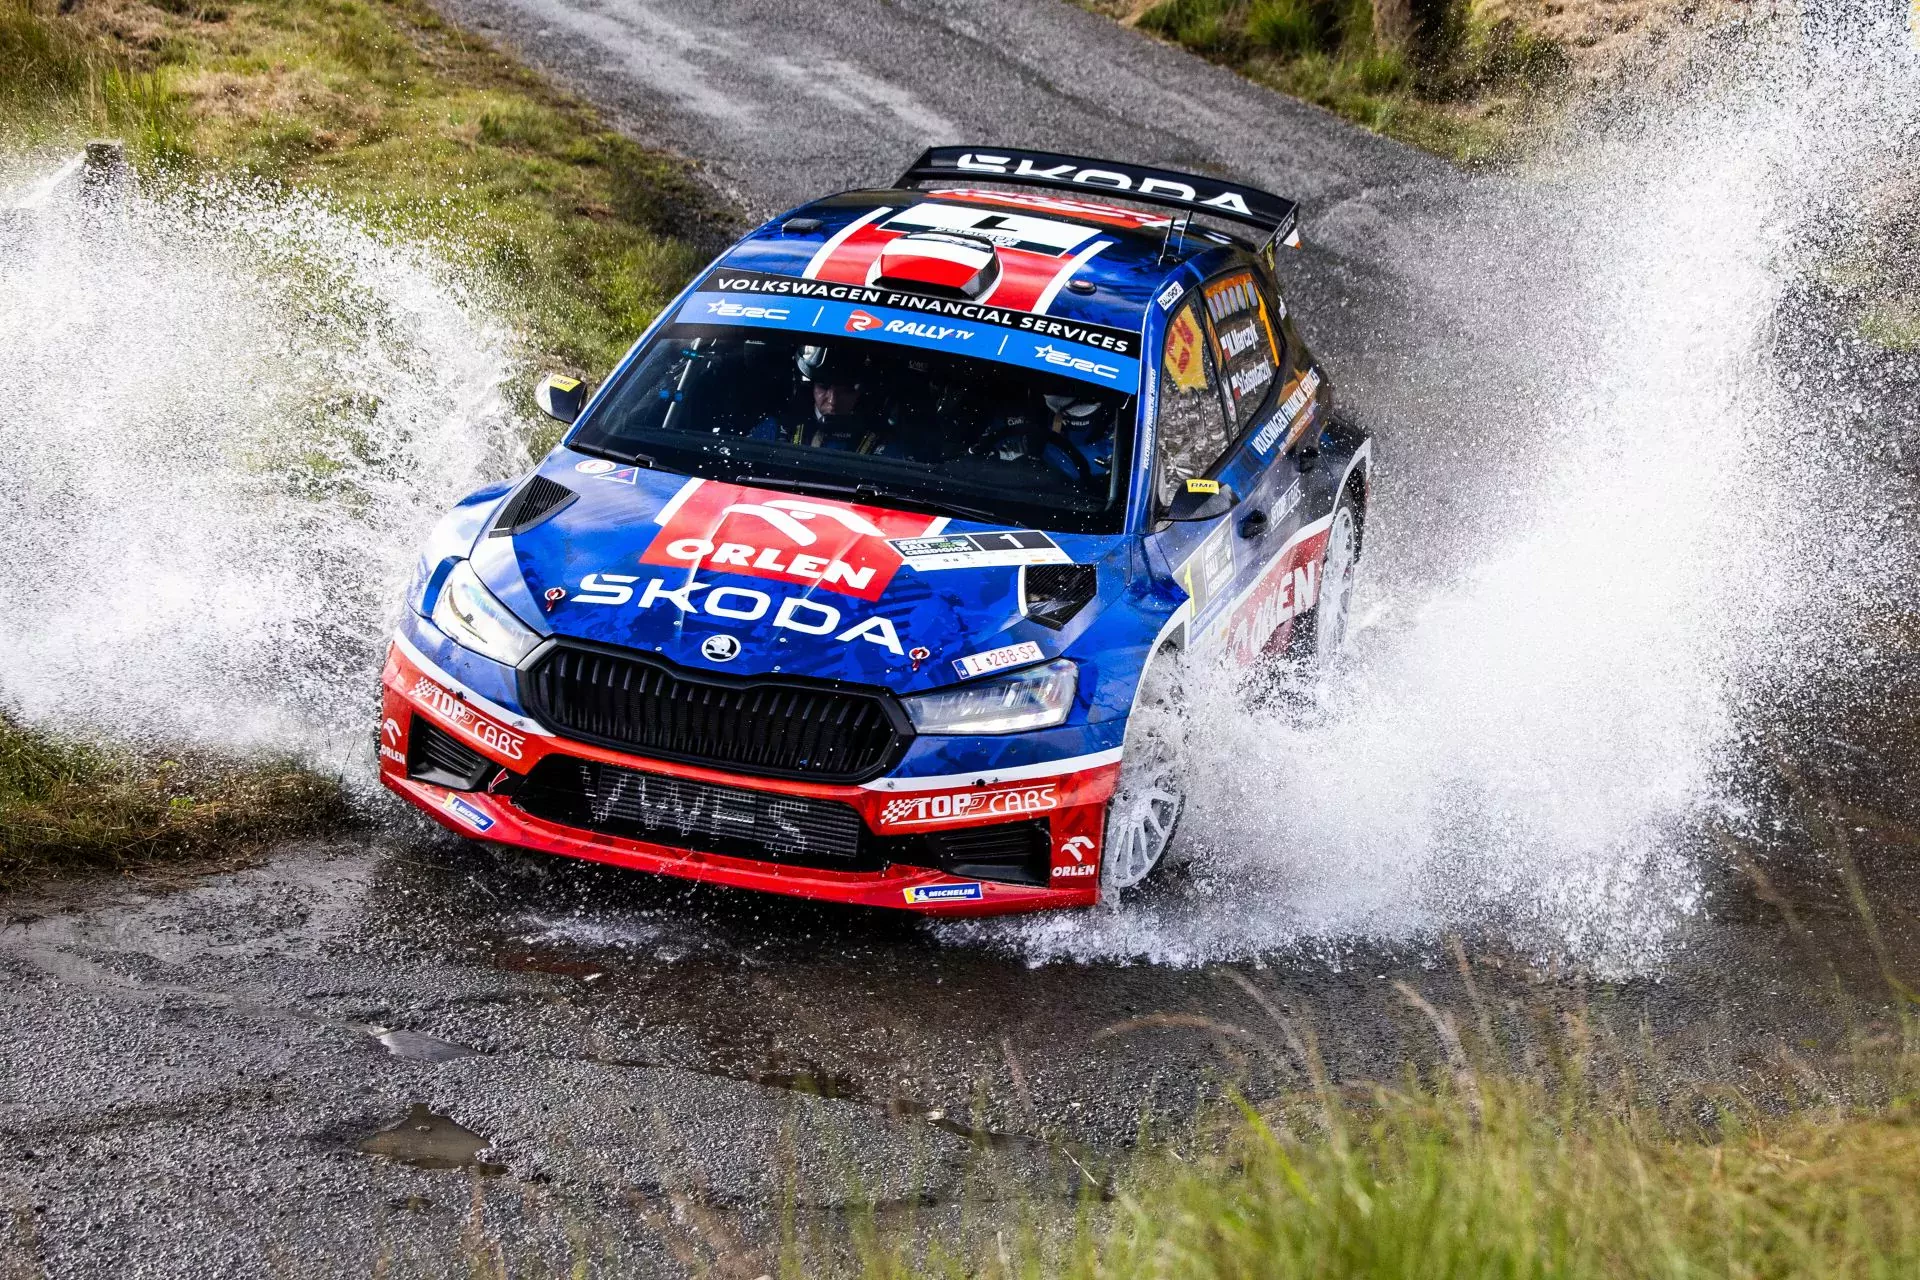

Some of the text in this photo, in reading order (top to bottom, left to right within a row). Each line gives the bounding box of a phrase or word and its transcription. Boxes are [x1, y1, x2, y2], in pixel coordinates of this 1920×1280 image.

[716, 302, 791, 321] ERC
[718, 278, 1129, 352] VOLKSWAGEN FINANCIAL SERVICES
[1045, 349, 1120, 380] ERC
[1251, 409, 1290, 456] VOLKSWAGEN
[999, 533, 1025, 549] 1
[666, 537, 878, 590] ORLEN
[473, 720, 525, 760] CARS
[379, 744, 406, 765] ORLEN
[989, 786, 1060, 814] CARS
[1051, 864, 1095, 878] ORLEN
[928, 886, 976, 898] MICHELIN
